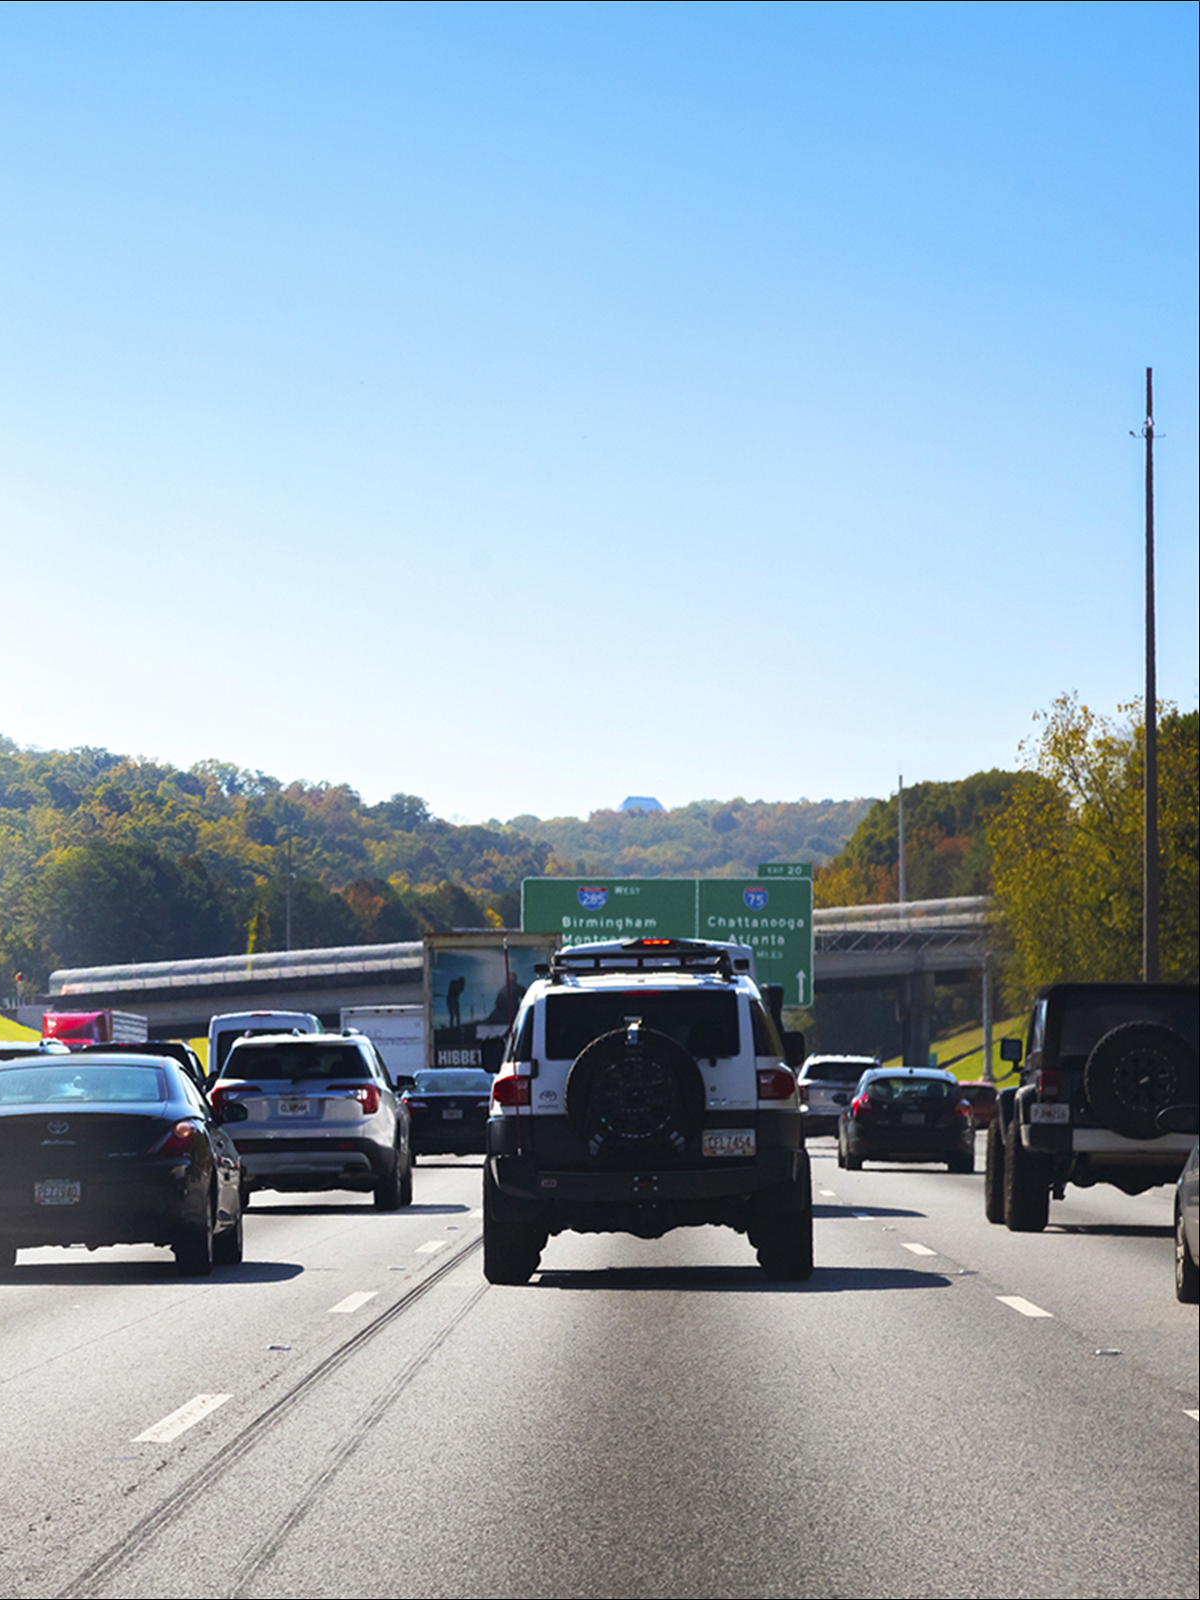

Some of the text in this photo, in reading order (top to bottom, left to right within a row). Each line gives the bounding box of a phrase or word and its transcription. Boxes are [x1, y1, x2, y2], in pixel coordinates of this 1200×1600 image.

[788, 866, 802, 876] 20
[582, 893, 606, 906] 285
[748, 893, 764, 906] 75
[561, 916, 657, 932] Birmingham
[707, 916, 805, 931] Chattanooga
[728, 934, 785, 946] Atlanta
